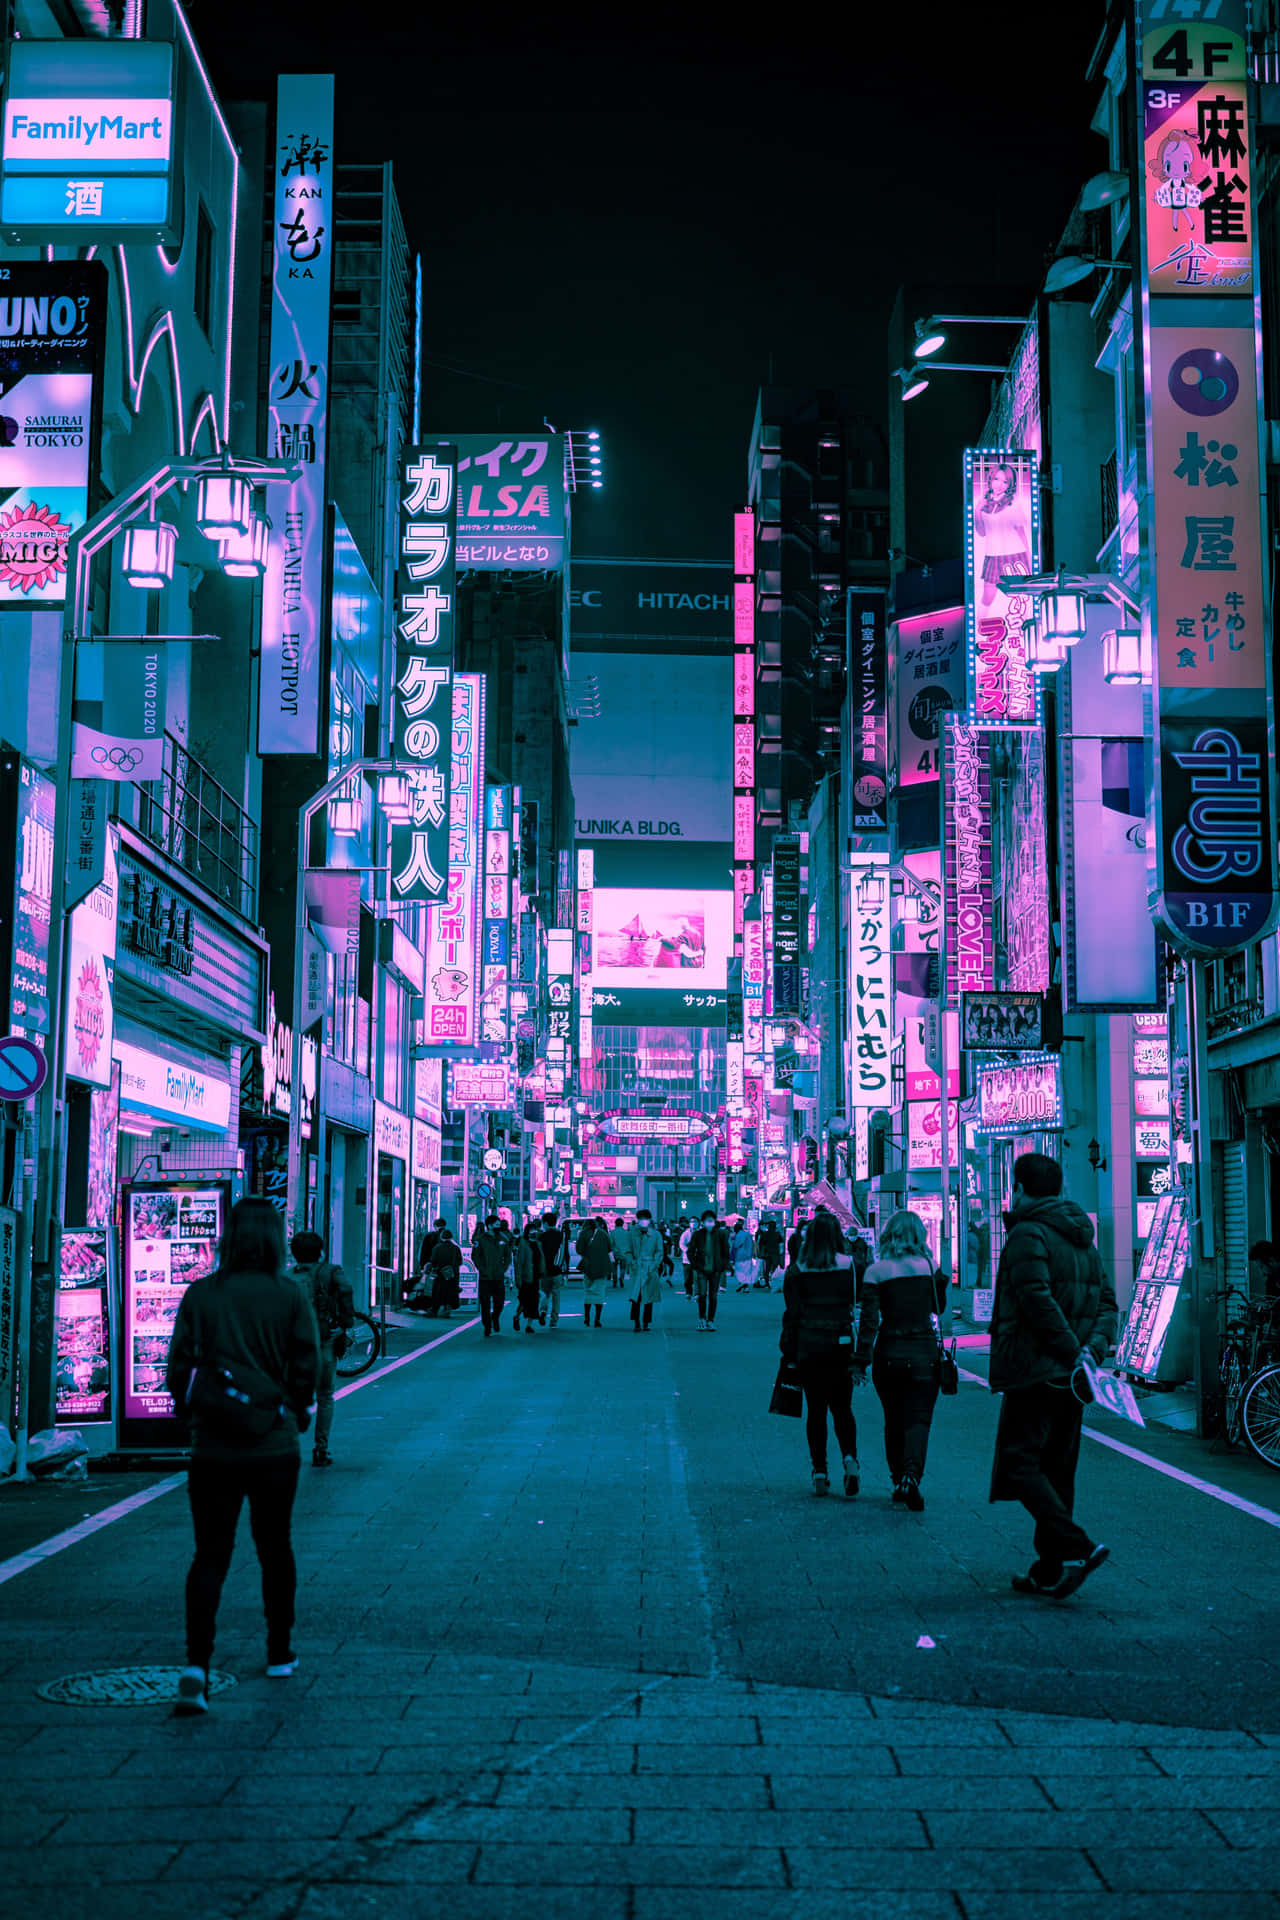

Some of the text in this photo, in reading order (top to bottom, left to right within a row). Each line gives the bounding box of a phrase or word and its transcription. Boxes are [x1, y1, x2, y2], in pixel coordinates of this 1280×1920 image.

[1153, 30, 1233, 77] 4F
[1148, 89, 1181, 109] 3F
[11, 115, 163, 146] FamilyMart
[1197, 95, 1248, 244] 麻雀
[65, 181, 104, 216] 酒
[285, 188, 322, 199] KAN
[289, 268, 315, 279] KA
[0, 296, 77, 337] UNO
[77, 296, 90, 336] ウーノ
[24, 415, 83, 426] SAMURAI
[274, 360, 320, 463] 火鍋
[23, 434, 83, 447] TOKYO
[458, 442, 549, 477] イク
[1173, 432, 1239, 571] 松屋
[282, 511, 304, 616] HUANHUA
[919, 627, 945, 645] 個室
[1201, 604, 1219, 662] カレー
[1224, 591, 1246, 652] 牛めし
[903, 640, 960, 665] ダイニング
[1175, 617, 1197, 668] 定食
[280, 632, 300, 716] HOTPOT
[393, 455, 454, 895] カラオケの鉄人
[860, 611, 876, 762] 個室ダイニング居酒屋
[913, 659, 951, 681] 居酒屋
[144, 653, 158, 734] TOKYO 2020
[859, 815, 878, 826] 入口
[1171, 728, 1262, 883] HUB
[574, 818, 685, 836] UNIKA BLDG.
[1186, 901, 1251, 927] B1F
[433, 1008, 465, 1022] 24h
[683, 994, 727, 1007] サッカー
[857, 912, 888, 1091] かつにいむら
[433, 1023, 465, 1034] OPEN
[166, 1067, 205, 1110] FamilyMart
[1008, 1090, 1055, 1122] 2,000円
[911, 1140, 934, 1149] 生ビール
